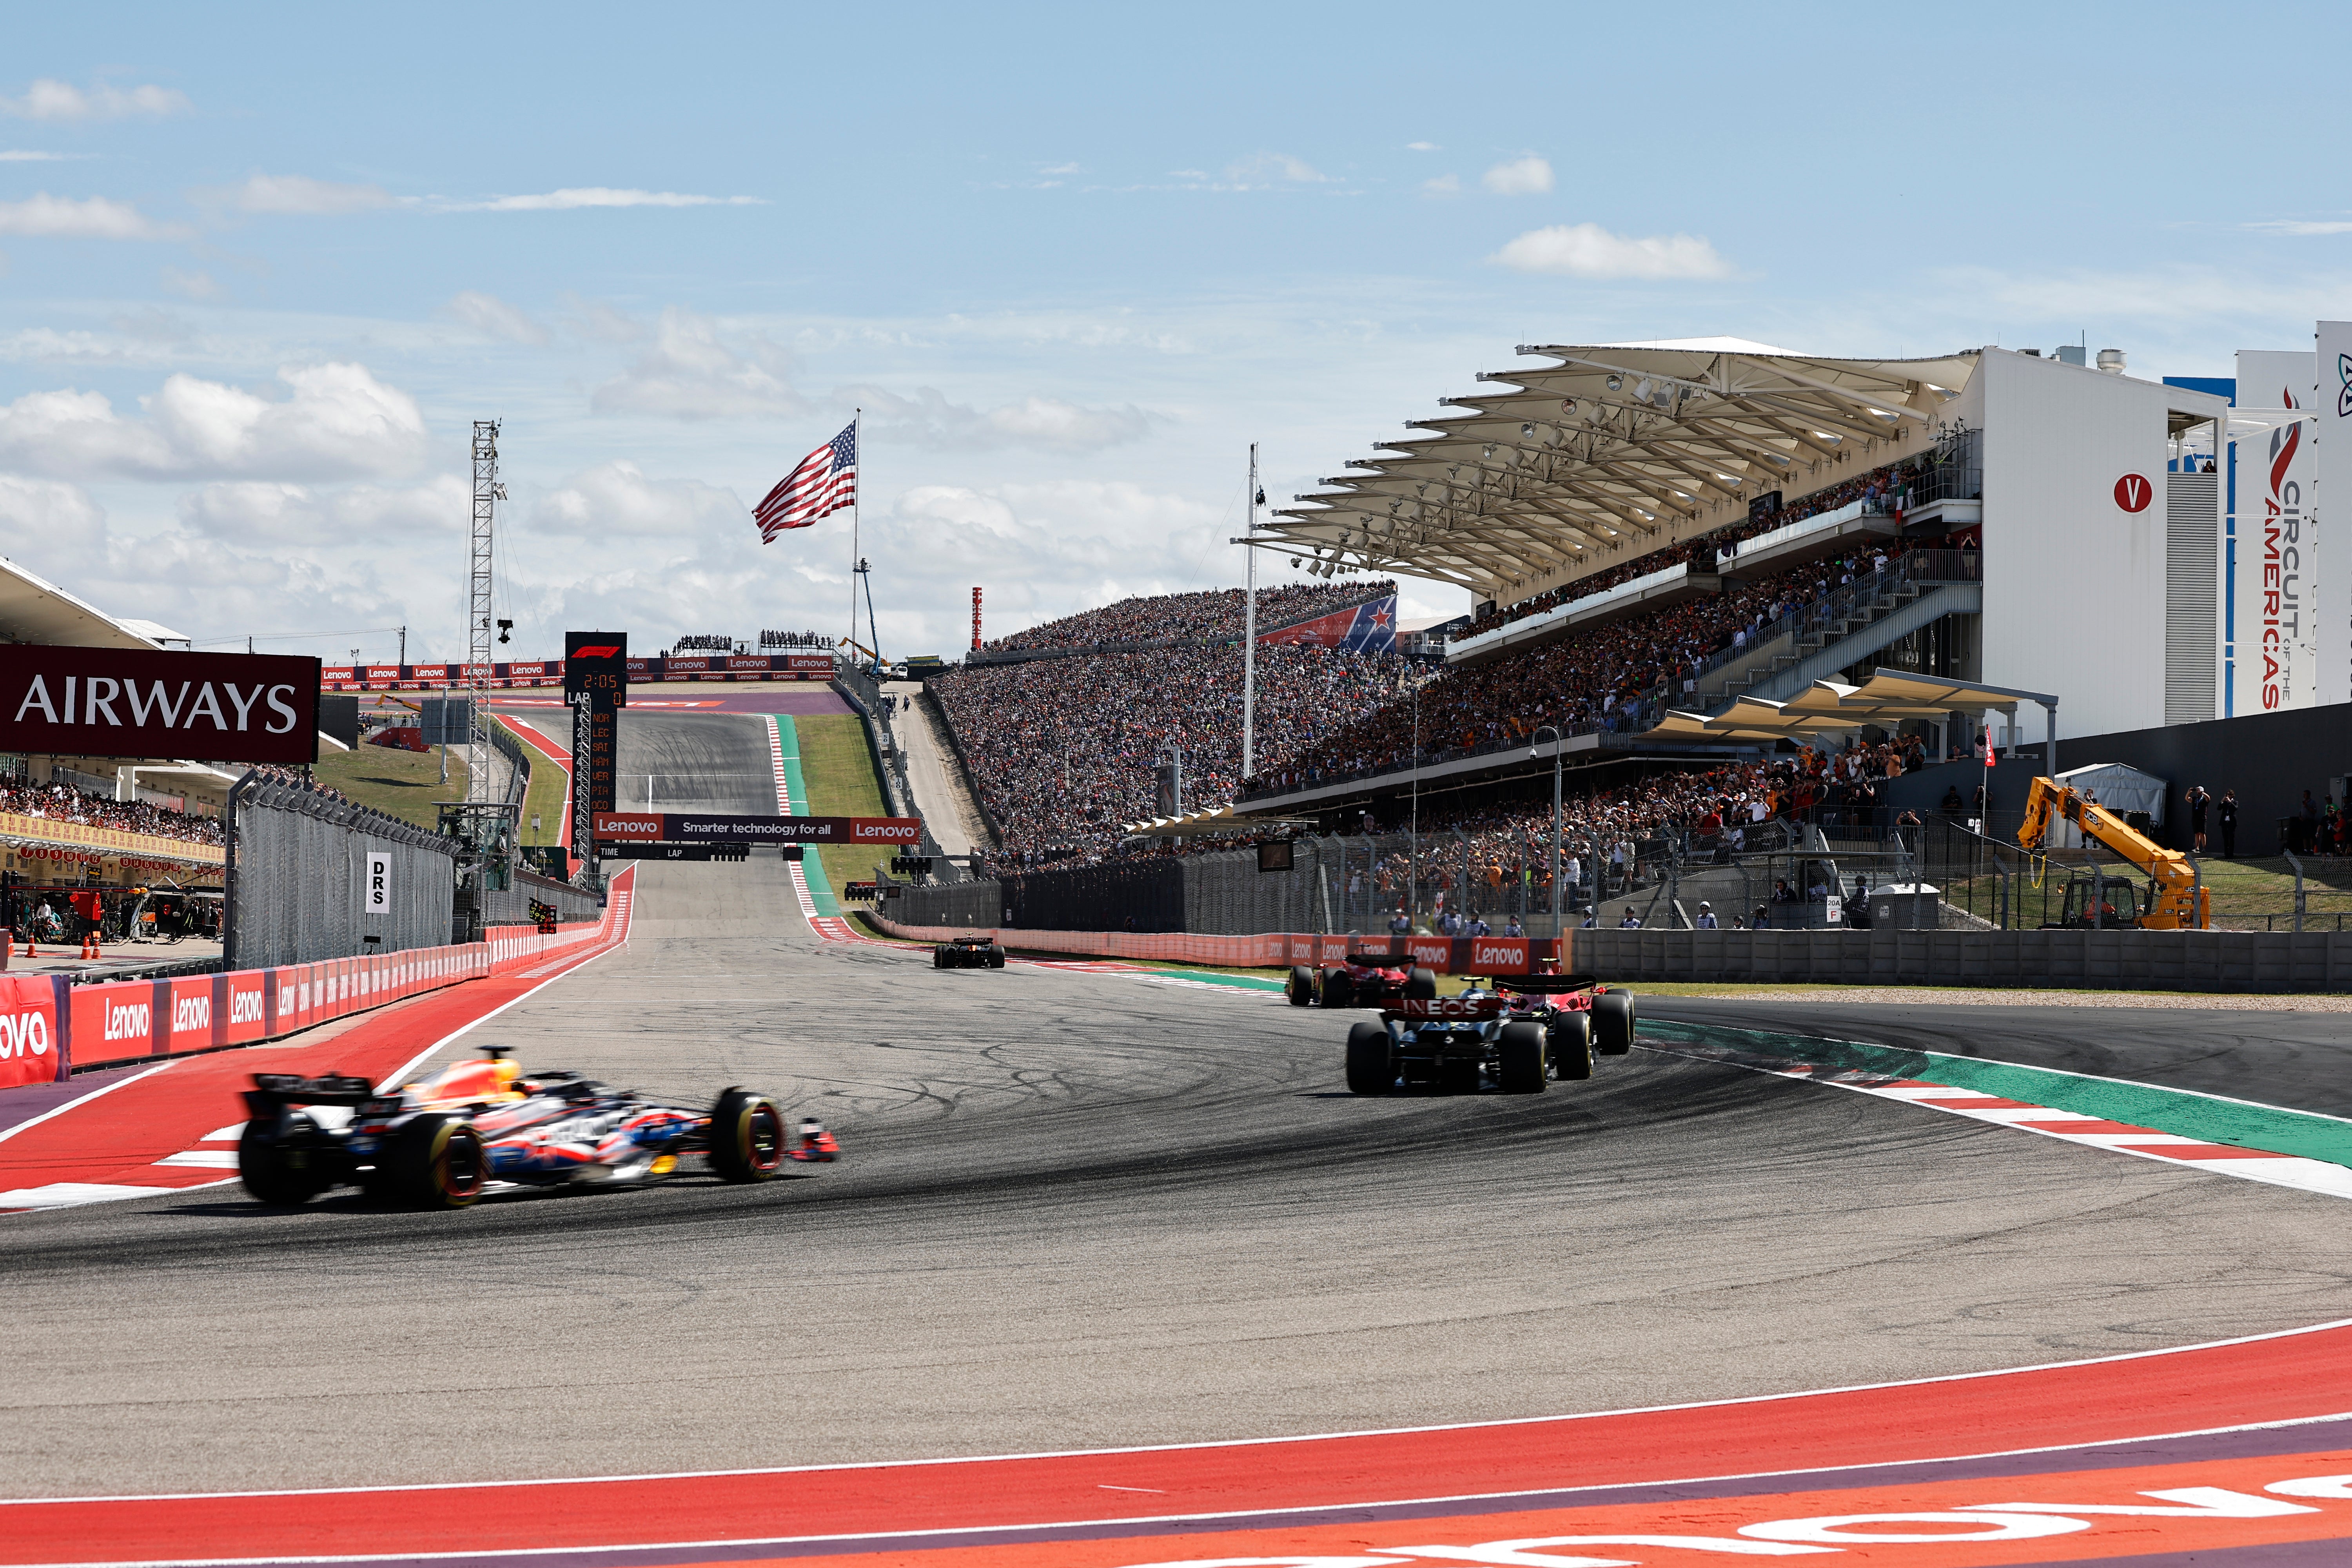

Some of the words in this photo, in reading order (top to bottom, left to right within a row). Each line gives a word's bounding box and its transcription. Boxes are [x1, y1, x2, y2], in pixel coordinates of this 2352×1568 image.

[2126, 478, 2141, 508] V
[2283, 481, 2300, 638] CIRCUIT
[2262, 496, 2281, 710] AMERICAS
[2283, 638, 2290, 662] OF
[512, 666, 542, 674] Lenovo
[669, 661, 706, 669] Lenovo
[730, 659, 767, 667] Lenovo
[791, 659, 828, 667] Lenovo
[323, 670, 351, 679] Lenovo
[369, 669, 397, 678] Lenovo
[416, 668, 444, 677] Lenovo
[584, 674, 617, 688] 2:05
[14, 674, 297, 733] AIRWAYS
[568, 692, 590, 704] LAP
[593, 713, 610, 722] NOR
[592, 728, 610, 737] LEC
[592, 742, 608, 751] SAI
[592, 757, 609, 766] HAM
[576, 771, 581, 781] 5
[592, 771, 608, 780] VER
[576, 786, 581, 796] 6
[592, 786, 608, 795] PIA
[592, 801, 608, 810] OCO
[2084, 810, 2098, 824] JCB
[599, 819, 657, 833] Lenovo
[683, 822, 729, 833] Smarter
[732, 823, 797, 836] technology
[799, 824, 815, 834] for
[818, 824, 831, 835] all
[856, 823, 915, 837] Lenovo
[601, 848, 619, 856] TIME
[668, 849, 682, 857] LAP
[372, 861, 384, 904] DRS
[1831, 911, 1837, 919] F
[1292, 939, 1311, 959] Lenovo
[1323, 940, 1346, 960] Lenovo
[1407, 942, 1446, 963] Lenovo
[1475, 942, 1523, 965] Lenovo
[230, 984, 262, 1024] Lenovo
[279, 978, 295, 1016] Lenovo
[173, 990, 209, 1033] Lenovo
[1403, 999, 1480, 1015] INEOS
[105, 998, 149, 1040] Lenovo
